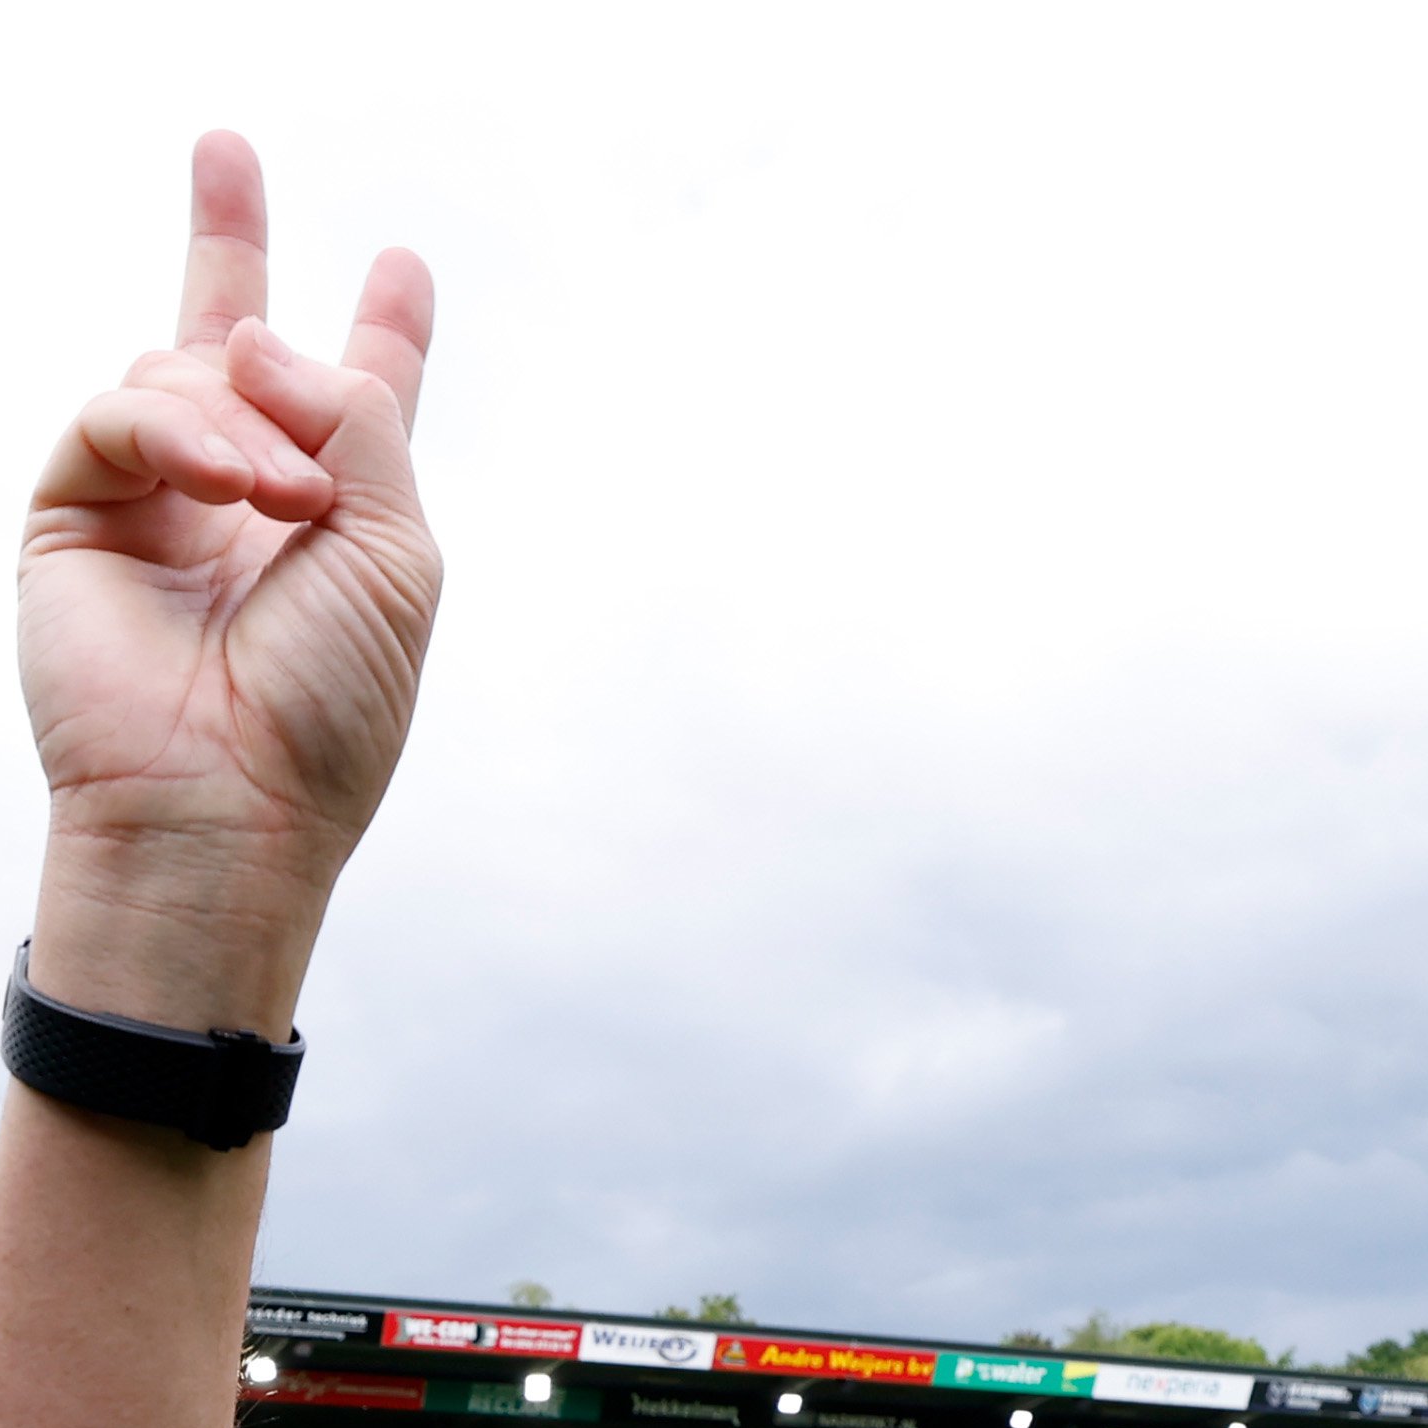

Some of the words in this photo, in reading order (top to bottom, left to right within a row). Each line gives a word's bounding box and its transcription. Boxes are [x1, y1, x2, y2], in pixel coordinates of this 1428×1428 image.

[759, 1344, 823, 1369] Andre
[828, 1350, 904, 1378] Weijers
[906, 1357, 935, 1377] bv
[1126, 1373, 1221, 1401] nexperia
